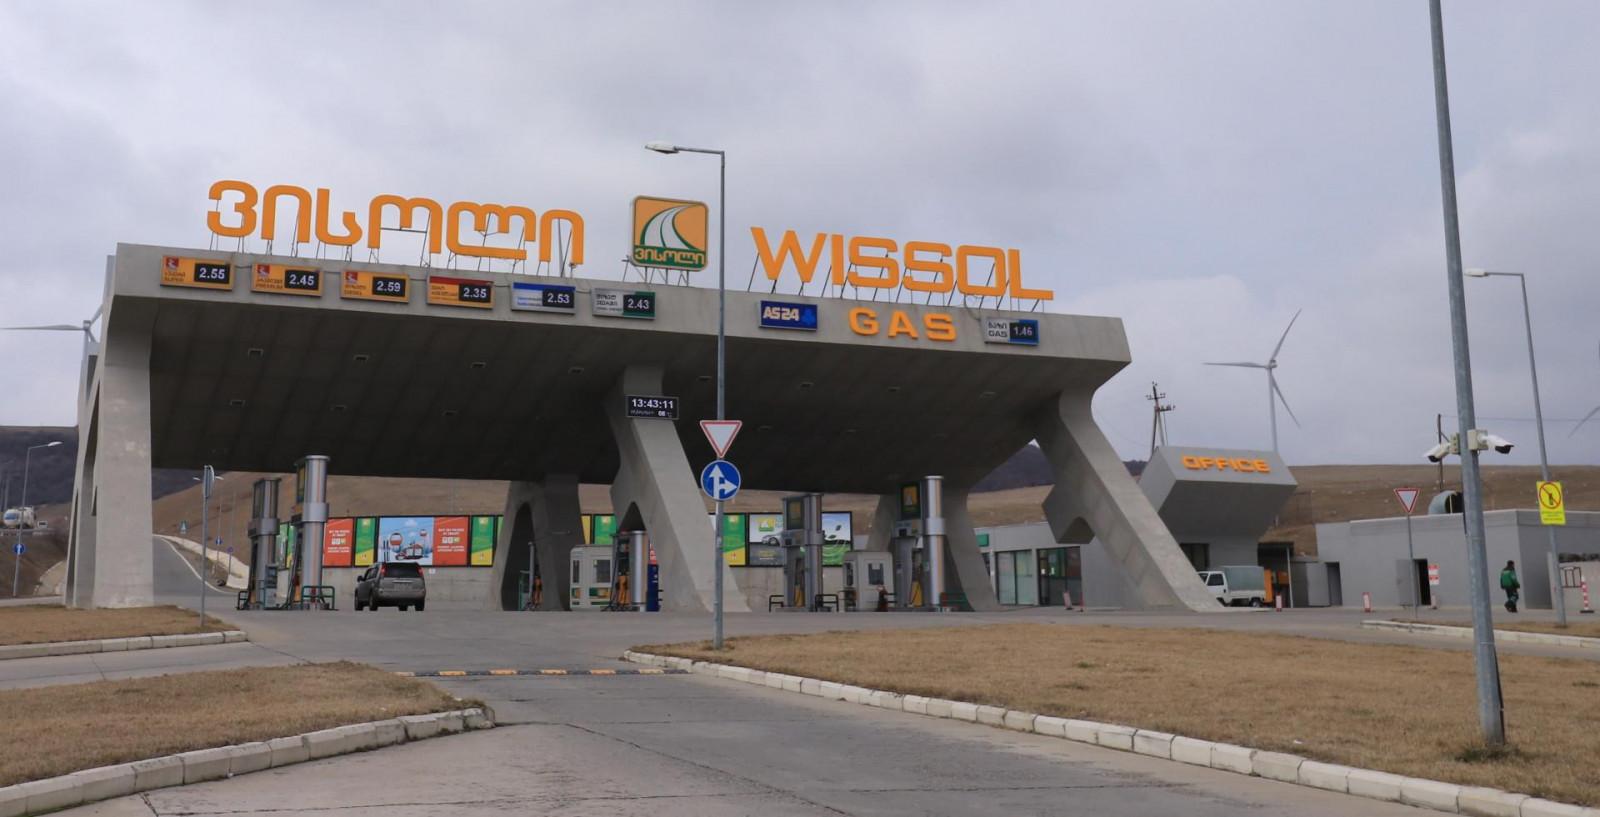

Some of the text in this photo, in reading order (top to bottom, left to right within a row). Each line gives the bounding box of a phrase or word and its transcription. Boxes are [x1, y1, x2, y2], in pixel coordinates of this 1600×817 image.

[751, 227, 1054, 300] WISSOL
[199, 267, 225, 280] 2.55
[289, 273, 315, 286] 2.45
[376, 280, 401, 292] 2.59
[463, 287, 488, 299] 2.35
[547, 292, 570, 304] 2.53
[627, 298, 650, 310] 2.43
[850, 307, 957, 342] GAS
[1014, 326, 1033, 336] 1.46
[631, 398, 673, 409] 13:43:11
[1184, 456, 1270, 473] OFFICE
